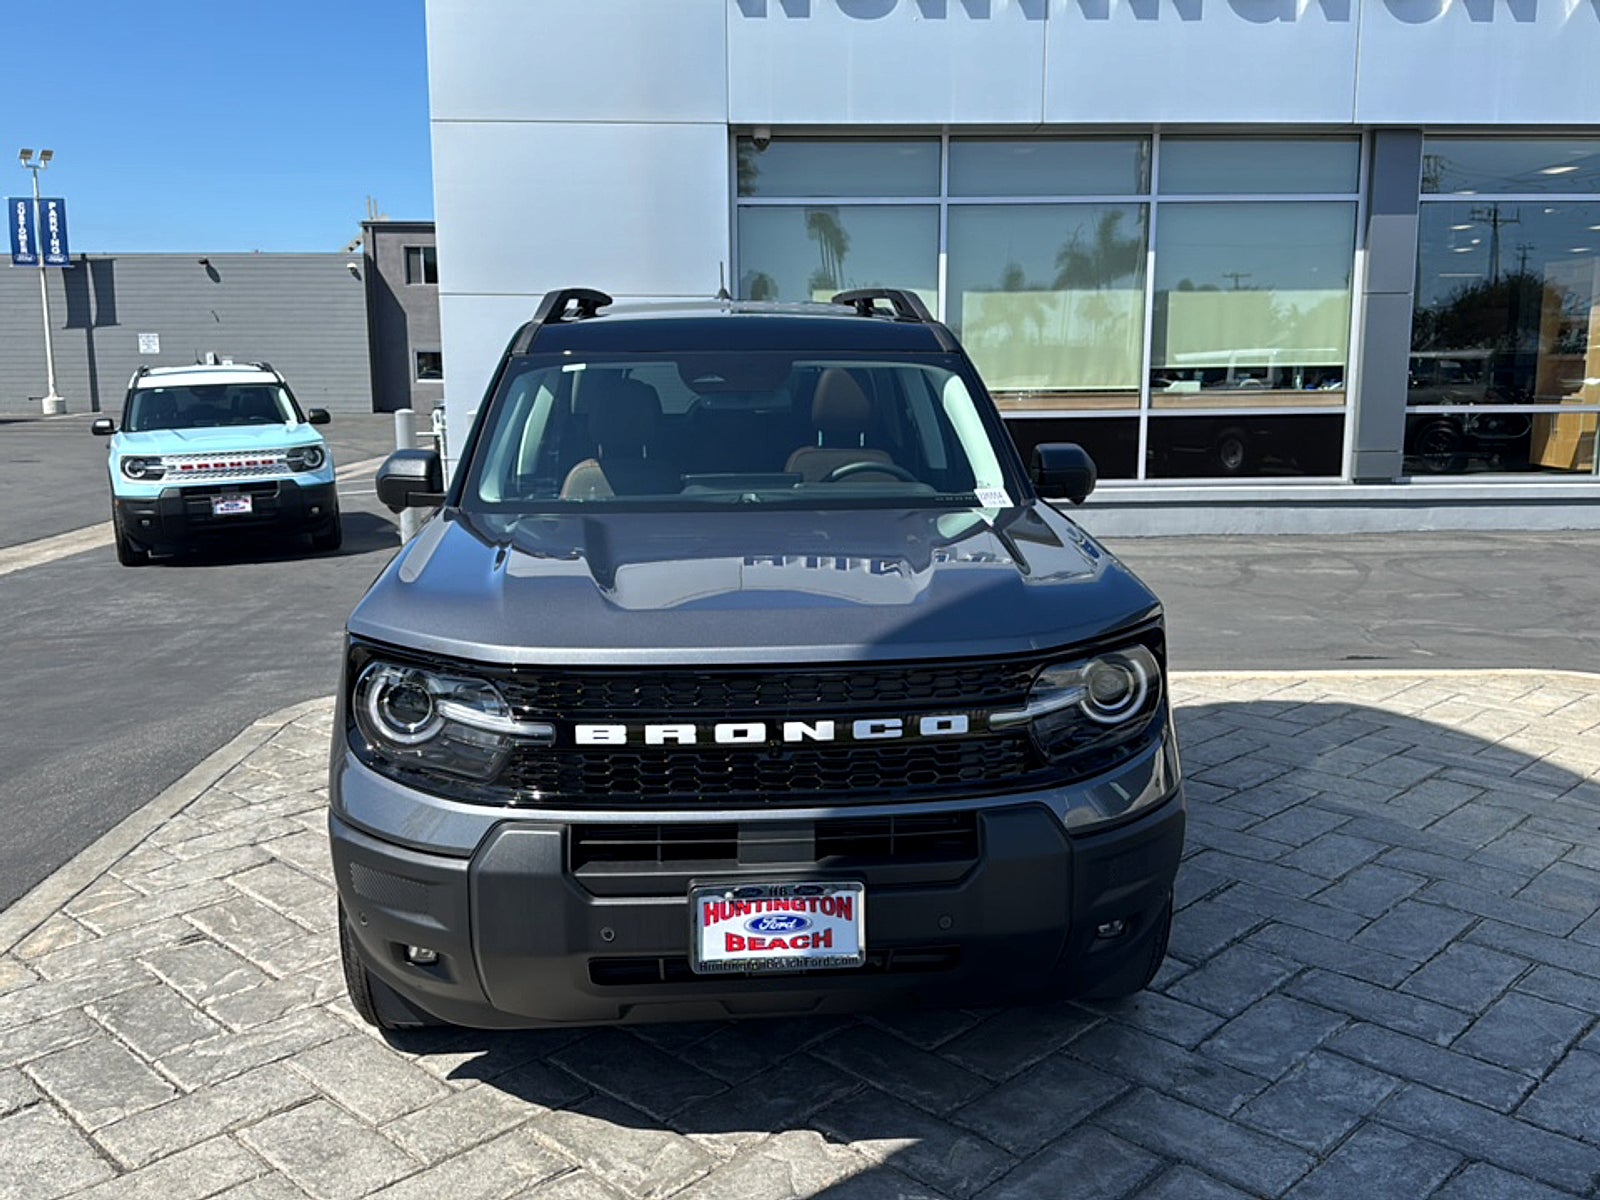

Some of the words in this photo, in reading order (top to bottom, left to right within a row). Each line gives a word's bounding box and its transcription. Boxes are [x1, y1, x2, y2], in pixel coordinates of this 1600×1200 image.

[48, 201, 61, 254] PARKING
[574, 714, 969, 745] BRONCO
[703, 896, 853, 927] HUNTINGTON
[758, 914, 796, 930] Ford
[725, 928, 833, 952] BEACH
